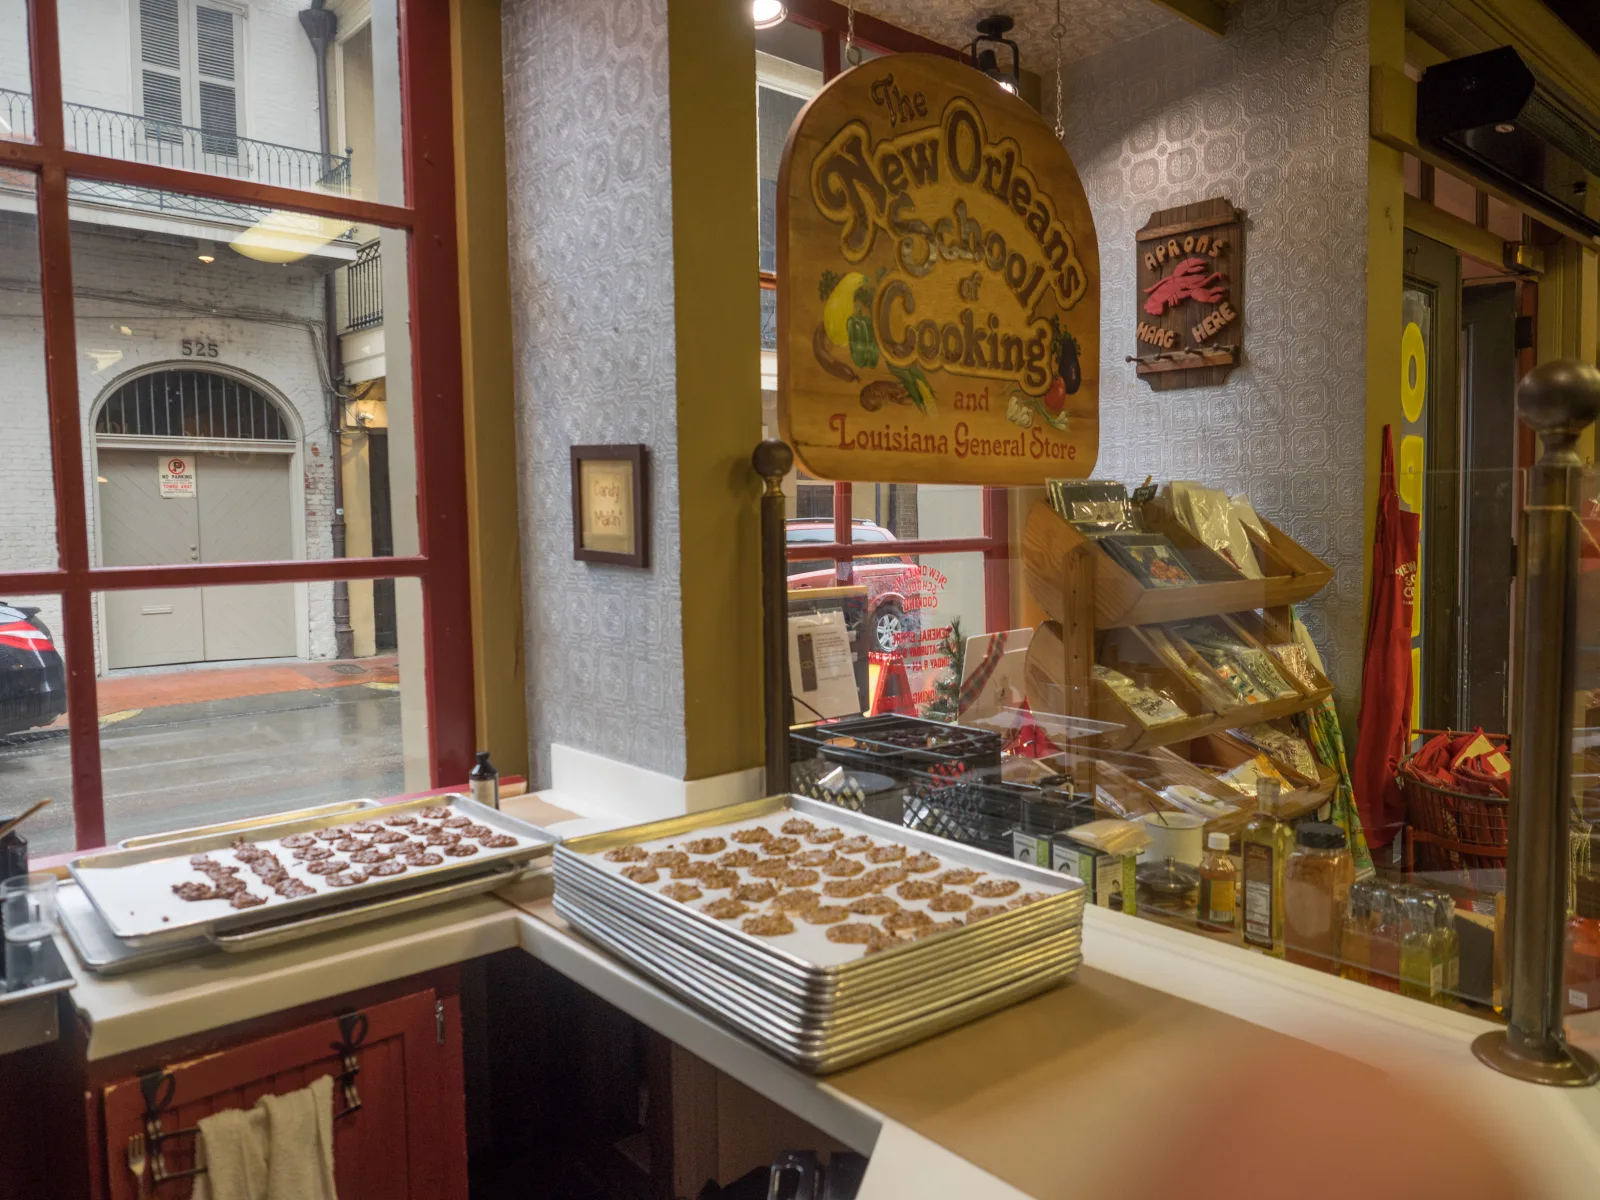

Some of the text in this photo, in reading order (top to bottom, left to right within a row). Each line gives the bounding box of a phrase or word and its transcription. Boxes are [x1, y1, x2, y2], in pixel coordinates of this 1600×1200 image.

[871, 73, 928, 128] The
[820, 109, 1081, 300] New Orleans
[888, 191, 1046, 307] School
[1144, 234, 1225, 271] APRONS
[957, 271, 983, 301] of
[181, 339, 219, 358] 525
[877, 280, 1048, 389] Cooking
[1136, 302, 1238, 349] HANG HERE
[953, 386, 989, 413] and
[828, 413, 1077, 461] Louisiana General Store
[593, 479, 620, 504] Candy
